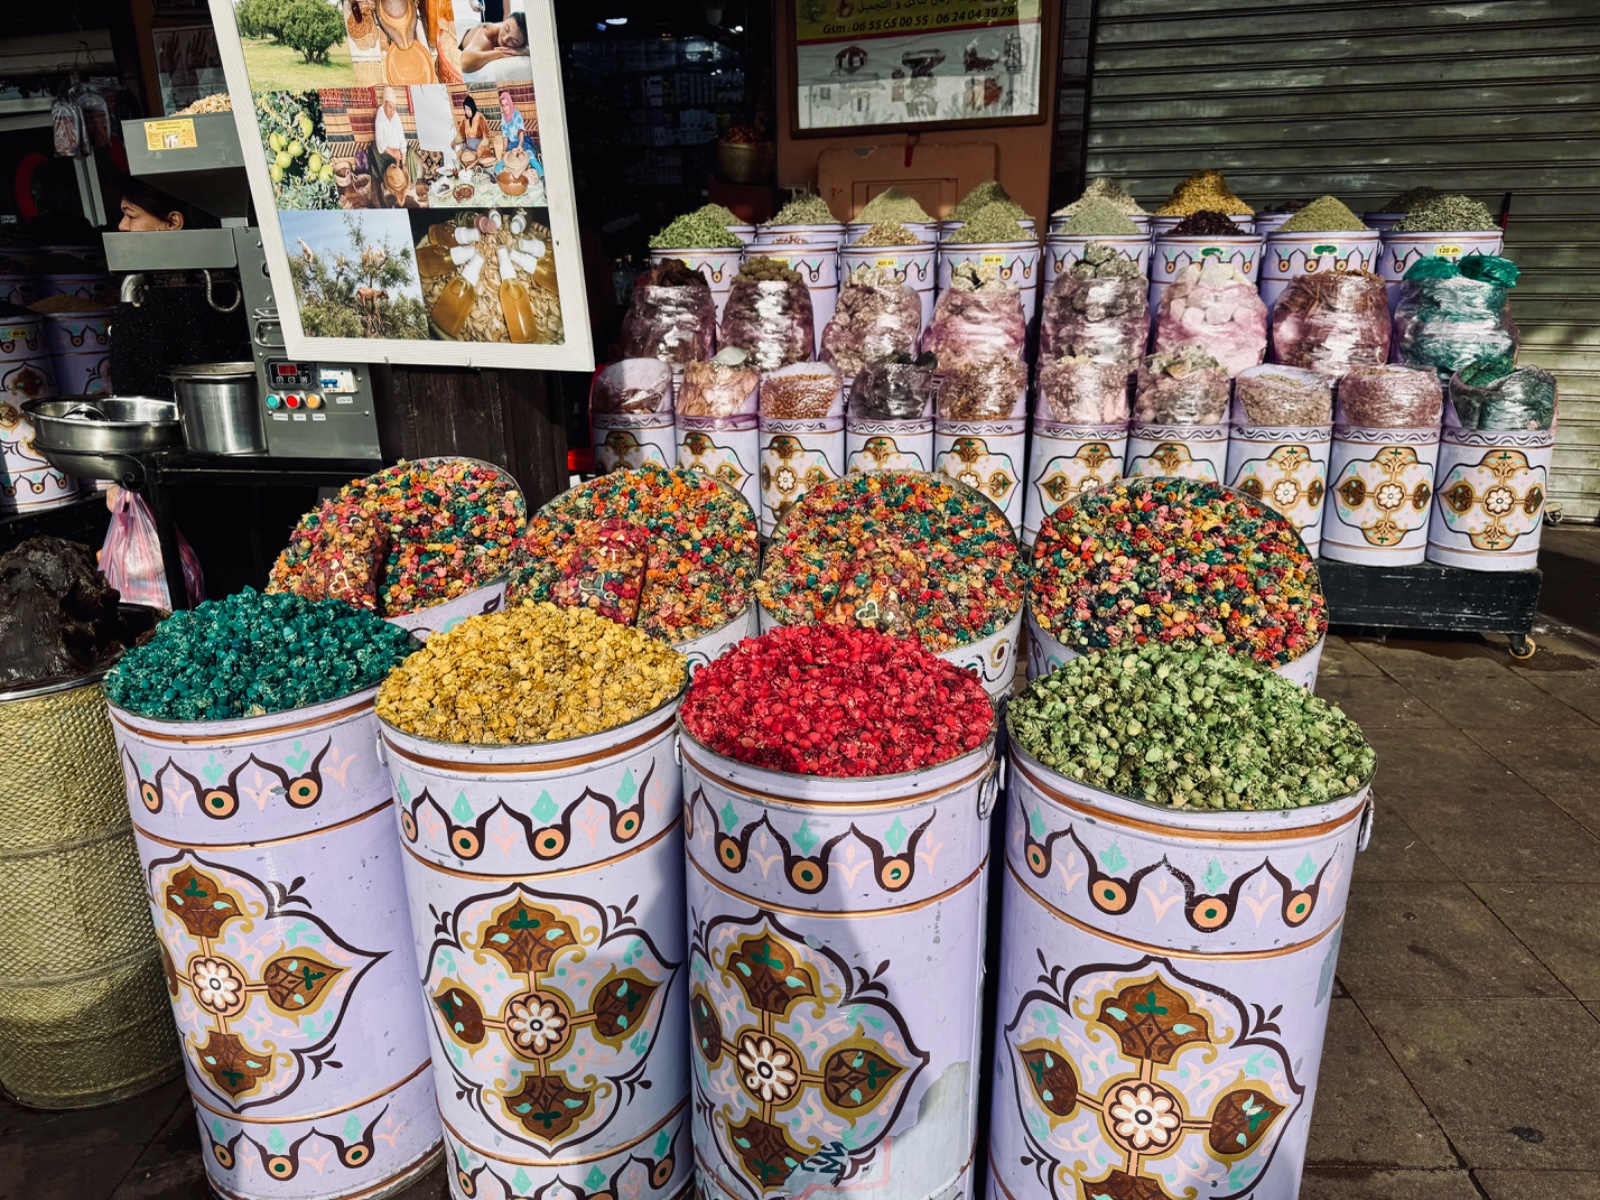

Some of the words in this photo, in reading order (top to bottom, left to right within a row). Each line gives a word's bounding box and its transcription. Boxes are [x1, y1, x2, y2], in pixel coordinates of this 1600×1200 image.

[823, 24, 845, 34] Gsm
[852, 21, 866, 31] 06
[868, 20, 881, 30] 55
[883, 17, 897, 29] 65
[899, 16, 913, 27] 00
[914, 15, 929, 26] 55
[936, 13, 950, 24] 06
[951, 11, 965, 21] 24
[967, 9, 981, 20] 04
[983, 7, 998, 18] 39
[1000, 6, 1015, 17] 79
